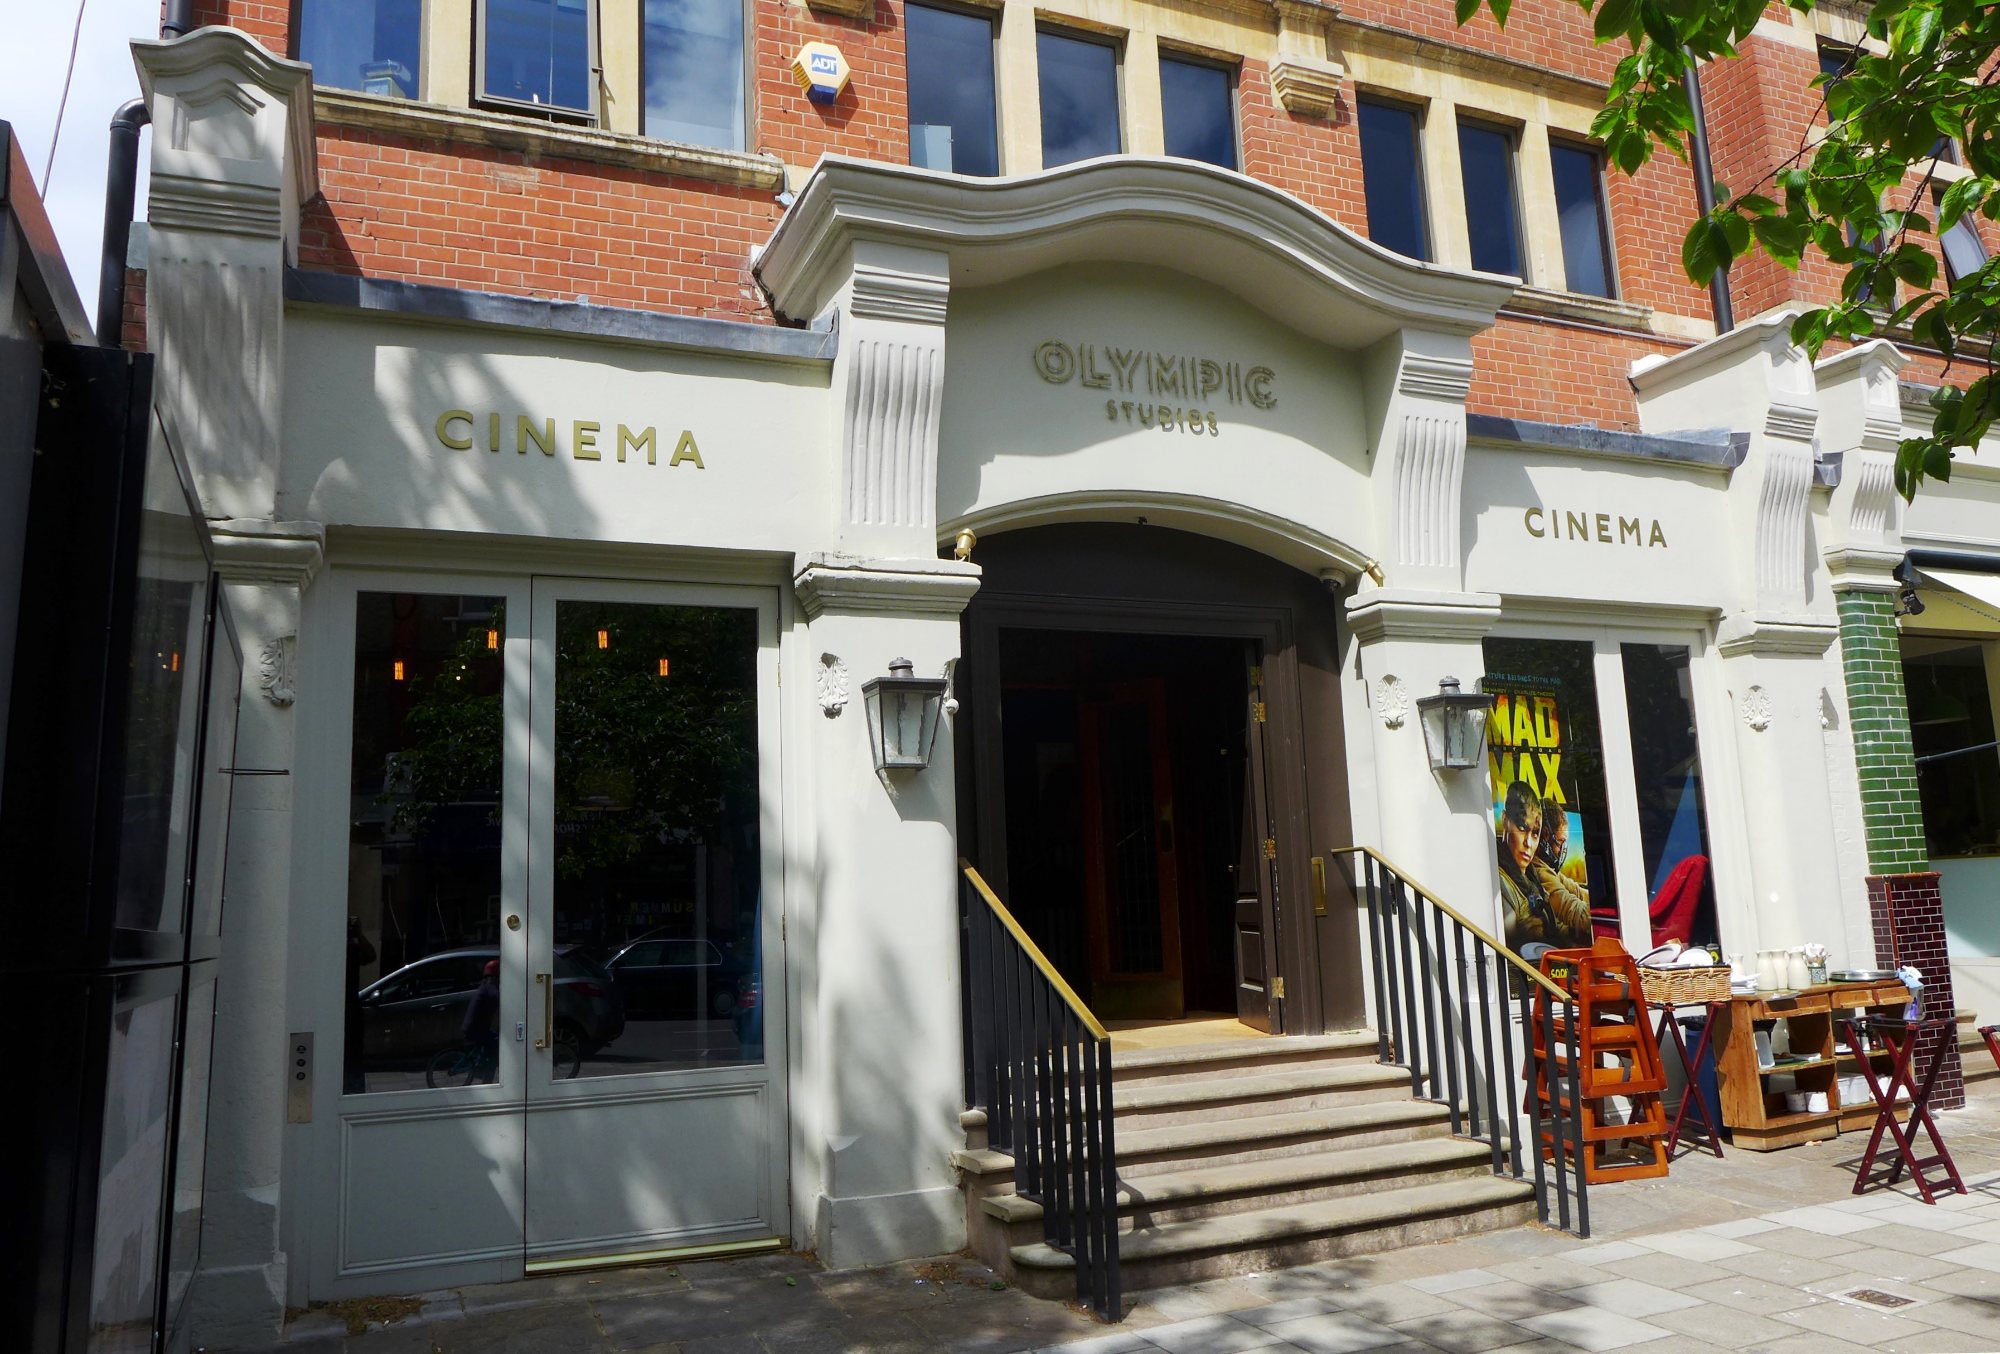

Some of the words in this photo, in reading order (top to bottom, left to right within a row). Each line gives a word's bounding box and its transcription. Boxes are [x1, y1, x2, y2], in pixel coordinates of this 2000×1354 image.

[812, 57, 837, 72] ADT
[1034, 338, 1278, 409] OLYMPIC
[1106, 399, 1219, 432] STUDIOS
[435, 409, 705, 470] CINEMA
[1524, 506, 1668, 548] CINEMA
[1488, 671, 1506, 681] TURE
[1485, 694, 1561, 749] MAD
[1488, 752, 1567, 805] MAX
